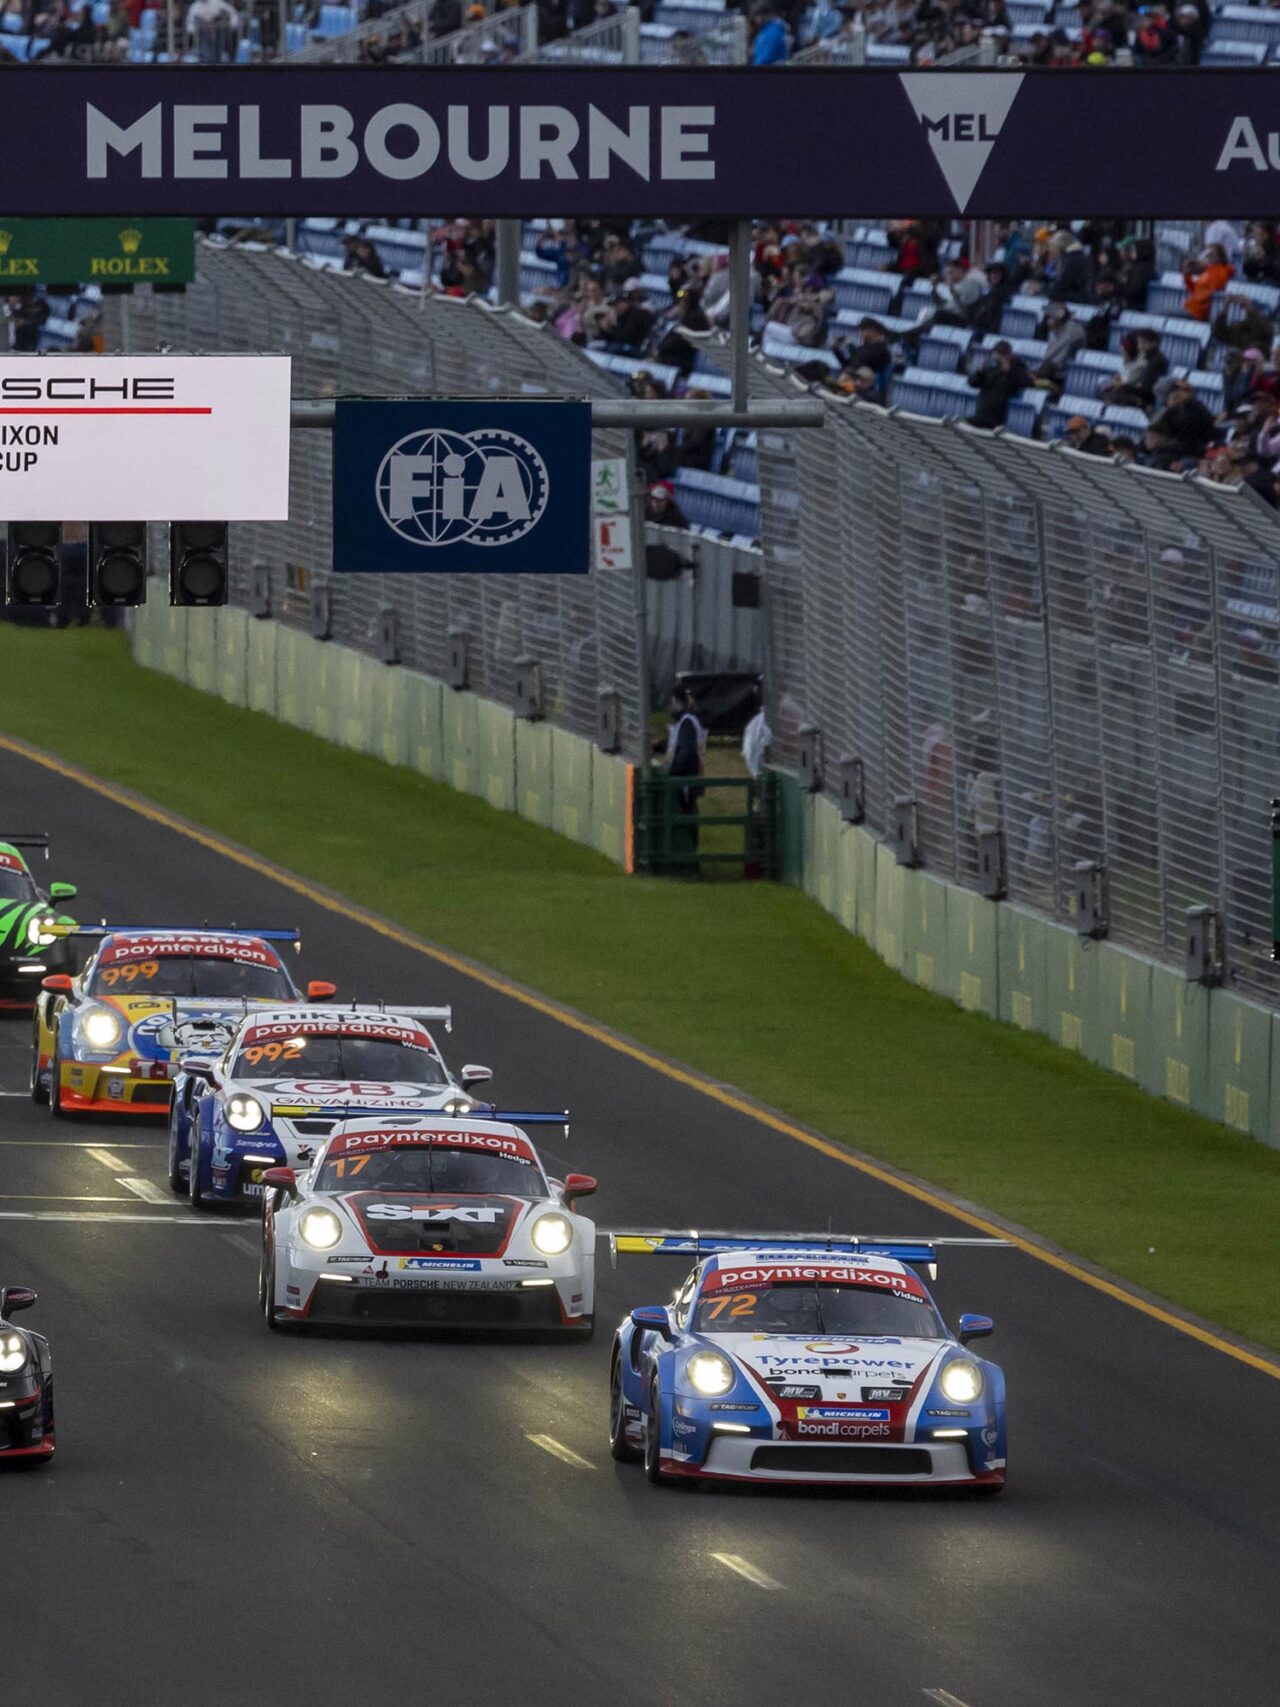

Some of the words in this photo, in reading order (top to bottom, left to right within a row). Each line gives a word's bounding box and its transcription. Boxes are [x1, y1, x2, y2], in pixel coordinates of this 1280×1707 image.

[921, 112, 998, 141] MEL
[86, 102, 716, 181] MELBOURNE
[90, 257, 170, 275] ROLEX
[114, 943, 267, 962] paynterdixon
[101, 961, 160, 987] 999
[272, 1012, 398, 1024] nikpol
[255, 1022, 415, 1041] paynterdixon
[244, 1042, 302, 1067] 992
[293, 1082, 396, 1097] GB
[345, 1131, 518, 1152] paynterdixon
[329, 1154, 371, 1178] 17
[498, 1151, 532, 1166] Hedge
[364, 1278, 390, 1288] TEAM
[393, 1279, 440, 1289] PORSCHE
[443, 1280, 468, 1289] NEW
[721, 1265, 907, 1289] paynterdixon
[703, 1294, 758, 1320] 72
[755, 1355, 916, 1370] Tyrepower
[823, 1410, 882, 1418] MICHELIN
